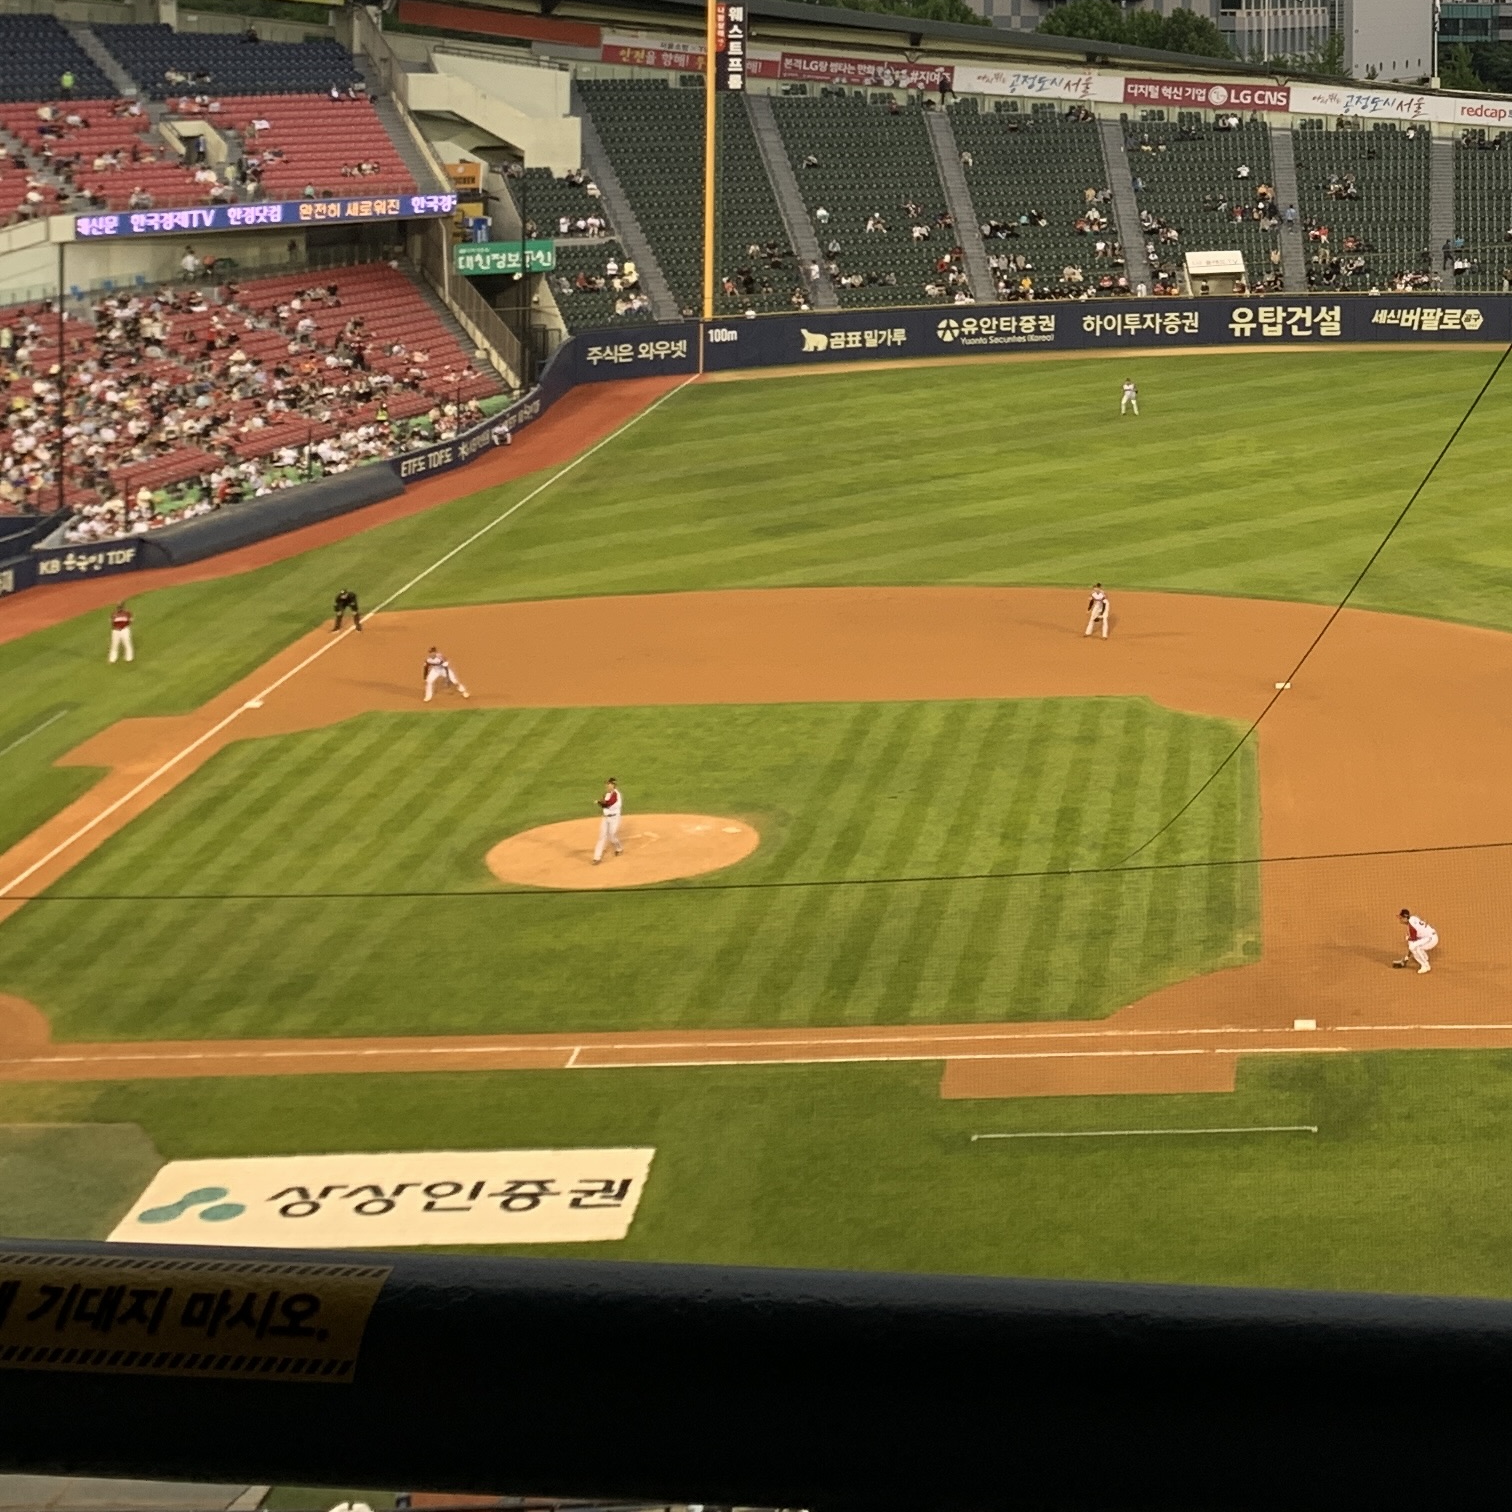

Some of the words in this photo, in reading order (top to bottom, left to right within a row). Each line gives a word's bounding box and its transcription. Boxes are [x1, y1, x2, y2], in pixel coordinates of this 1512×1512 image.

[1127, 85, 1160, 100] 디지털
[1161, 86, 1183, 101] 혁신
[1184, 87, 1207, 103] 기업
[1231, 90, 1252, 104] LG
[1254, 91, 1288, 106] CNS
[1460, 104, 1507, 123] redcap
[130, 208, 215, 233] 한국경제TV
[960, 314, 1056, 336] 유안타증권
[1082, 311, 1199, 337] 하이투자증권
[1228, 305, 1342, 337] 유탑건설
[708, 328, 738, 343] 100m
[829, 331, 863, 350] 곰표
[863, 329, 907, 349] 밀가루
[586, 343, 633, 366] 주식은
[637, 340, 688, 361] 와우넷
[266, 1178, 633, 1218] 상상인증권
[26, 1283, 173, 1336] 기대지
[180, 1289, 330, 1342] 마시오.
